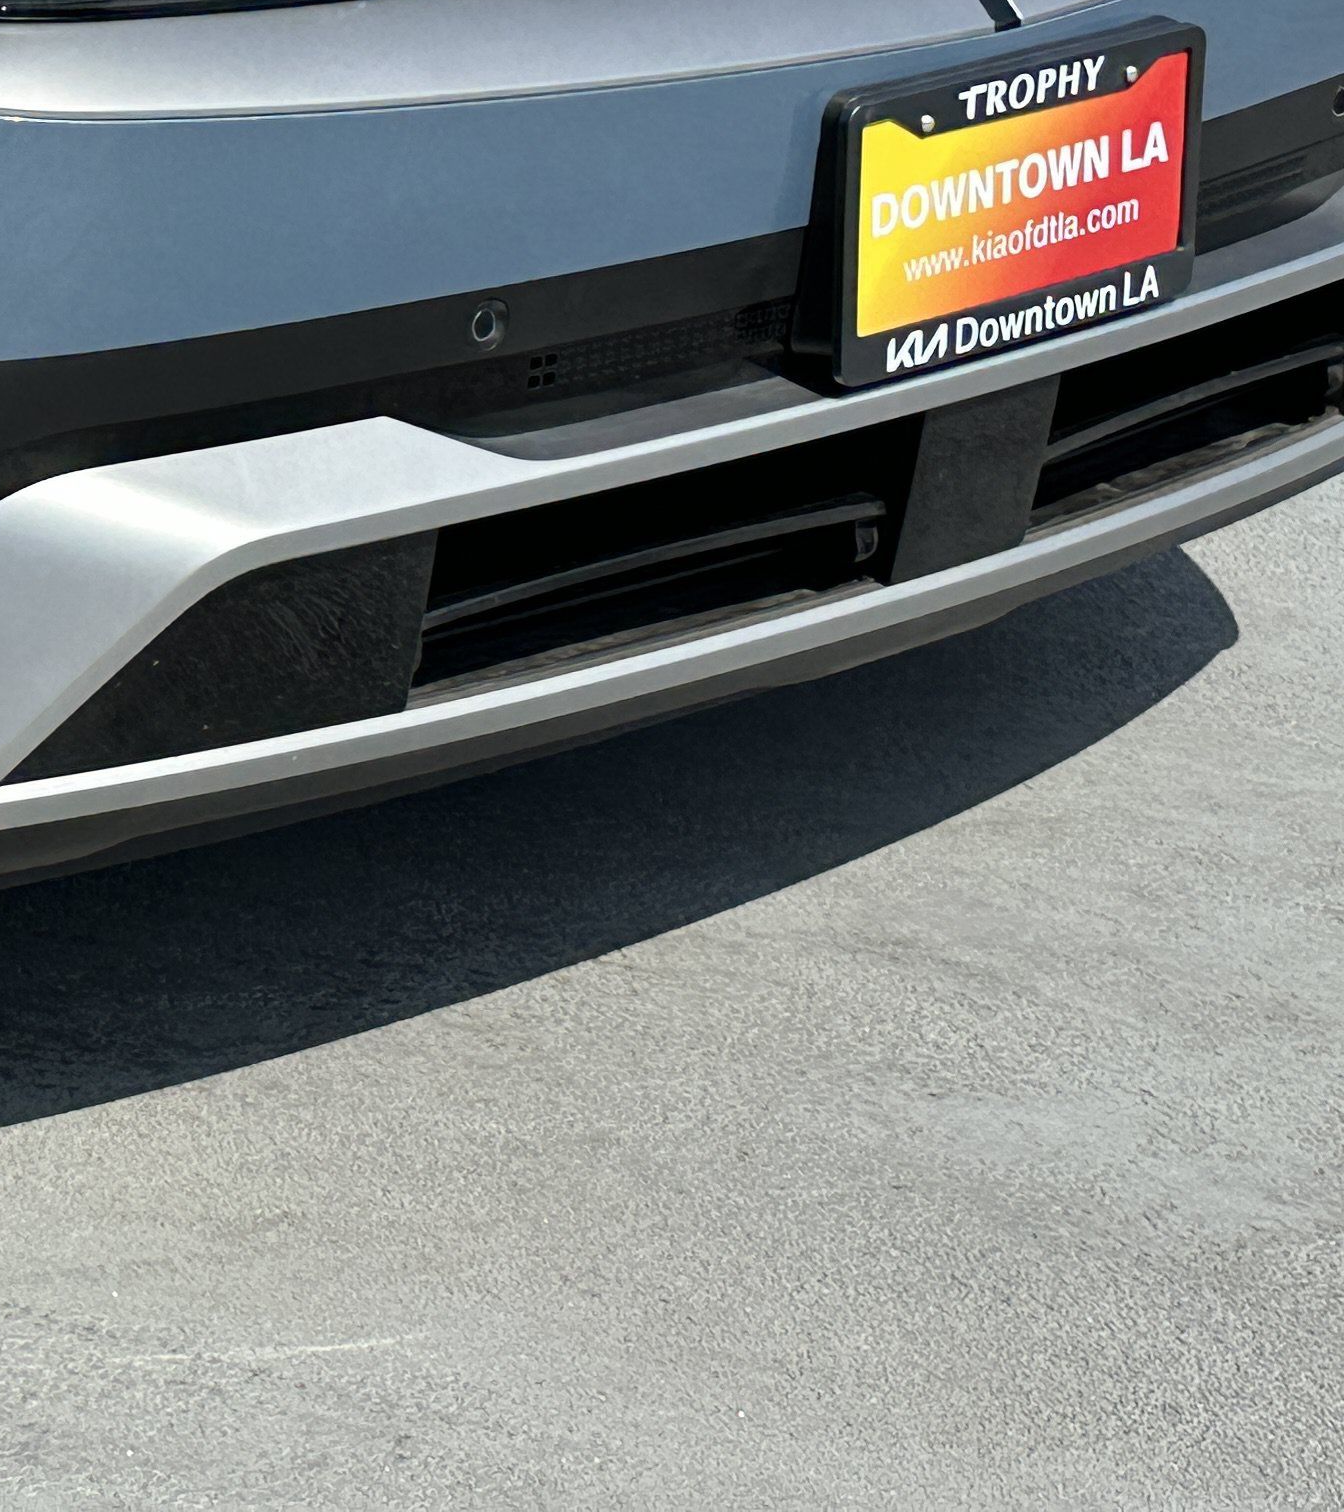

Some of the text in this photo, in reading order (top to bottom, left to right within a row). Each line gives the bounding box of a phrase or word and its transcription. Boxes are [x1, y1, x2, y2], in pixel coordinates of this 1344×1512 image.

[958, 55, 1105, 120] TROPHY
[872, 121, 1169, 238] DOWNTOWN LA
[902, 197, 1140, 283] www.kiaofdtla.com
[886, 264, 1159, 374] KIA Downtown LA
